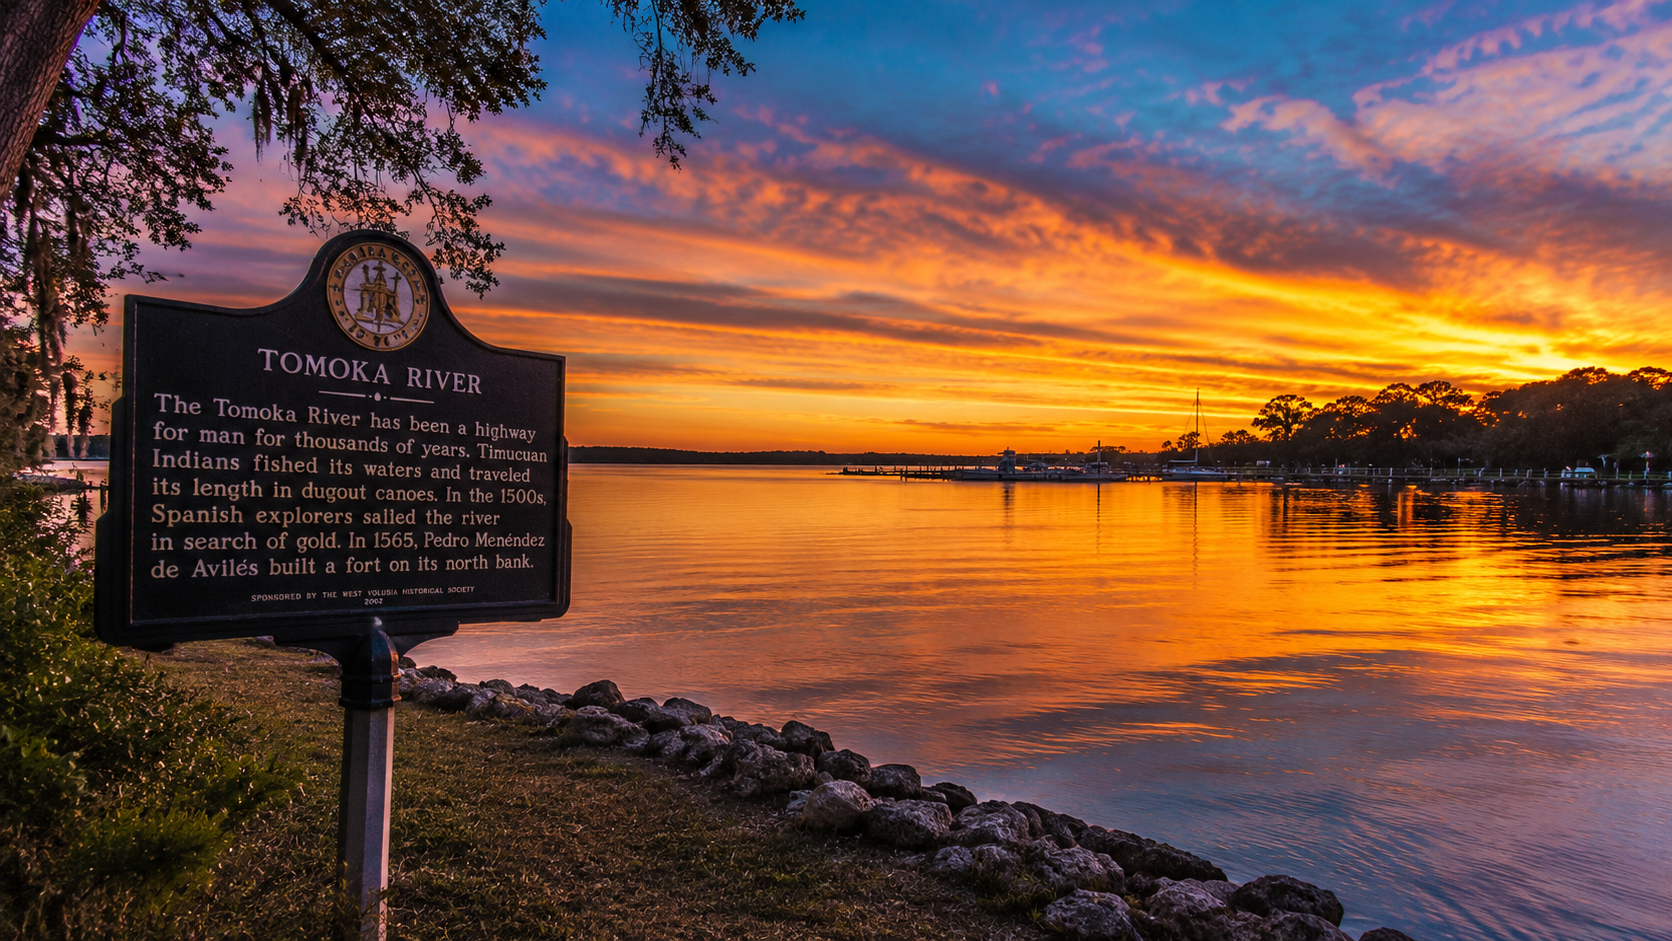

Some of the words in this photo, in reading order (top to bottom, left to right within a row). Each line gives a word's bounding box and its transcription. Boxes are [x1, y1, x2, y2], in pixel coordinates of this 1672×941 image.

[258, 347, 392, 385] TOMOKA
[407, 367, 481, 394] RIVER
[154, 393, 201, 414] The
[213, 398, 297, 422] Tomoka
[308, 406, 360, 426] River
[370, 412, 400, 429] has
[410, 415, 449, 433] been
[458, 424, 467, 435] a
[475, 421, 536, 443] highway
[153, 421, 188, 441] for
[199, 430, 245, 444] man
[255, 428, 285, 446] for
[294, 431, 388, 452] thousands
[396, 439, 415, 454] of
[421, 444, 470, 458] years.
[477, 443, 547, 462] Timucuan
[153, 448, 239, 470] Indians
[254, 454, 318, 473] fished
[330, 459, 352, 475] its
[364, 462, 421, 478] waters
[431, 464, 460, 479] and
[469, 467, 530, 482] traveled
[153, 477, 180, 495] its
[193, 478, 263, 501] length
[273, 481, 292, 498] in
[302, 482, 366, 503] dugout
[376, 489, 437, 501] canoes.
[446, 487, 461, 502] In
[469, 488, 493, 503] the
[501, 488, 546, 506] 1500s,
[152, 504, 243, 527] Spanish
[256, 507, 352, 528] explorers
[426, 509, 452, 524] the
[462, 511, 500, 525] river
[151, 533, 173, 550] in
[184, 532, 257, 550] search
[267, 532, 288, 549] of
[297, 532, 341, 553] gold.
[349, 532, 366, 548] In
[374, 532, 417, 550] 1565,
[424, 532, 469, 547] Pedro
[475, 532, 545, 547] Menéndez
[151, 560, 178, 578] de
[191, 559, 258, 577] Avilés
[269, 558, 316, 575] built
[325, 562, 336, 573] a
[346, 557, 381, 573] fort
[389, 560, 410, 572] on
[418, 556, 437, 571] its
[446, 555, 488, 570] north
[496, 554, 533, 569] bank.
[250, 592, 302, 603] SPONSORED
[305, 592, 318, 600] BY
[321, 591, 338, 599] THE
[341, 589, 363, 598] WEST
